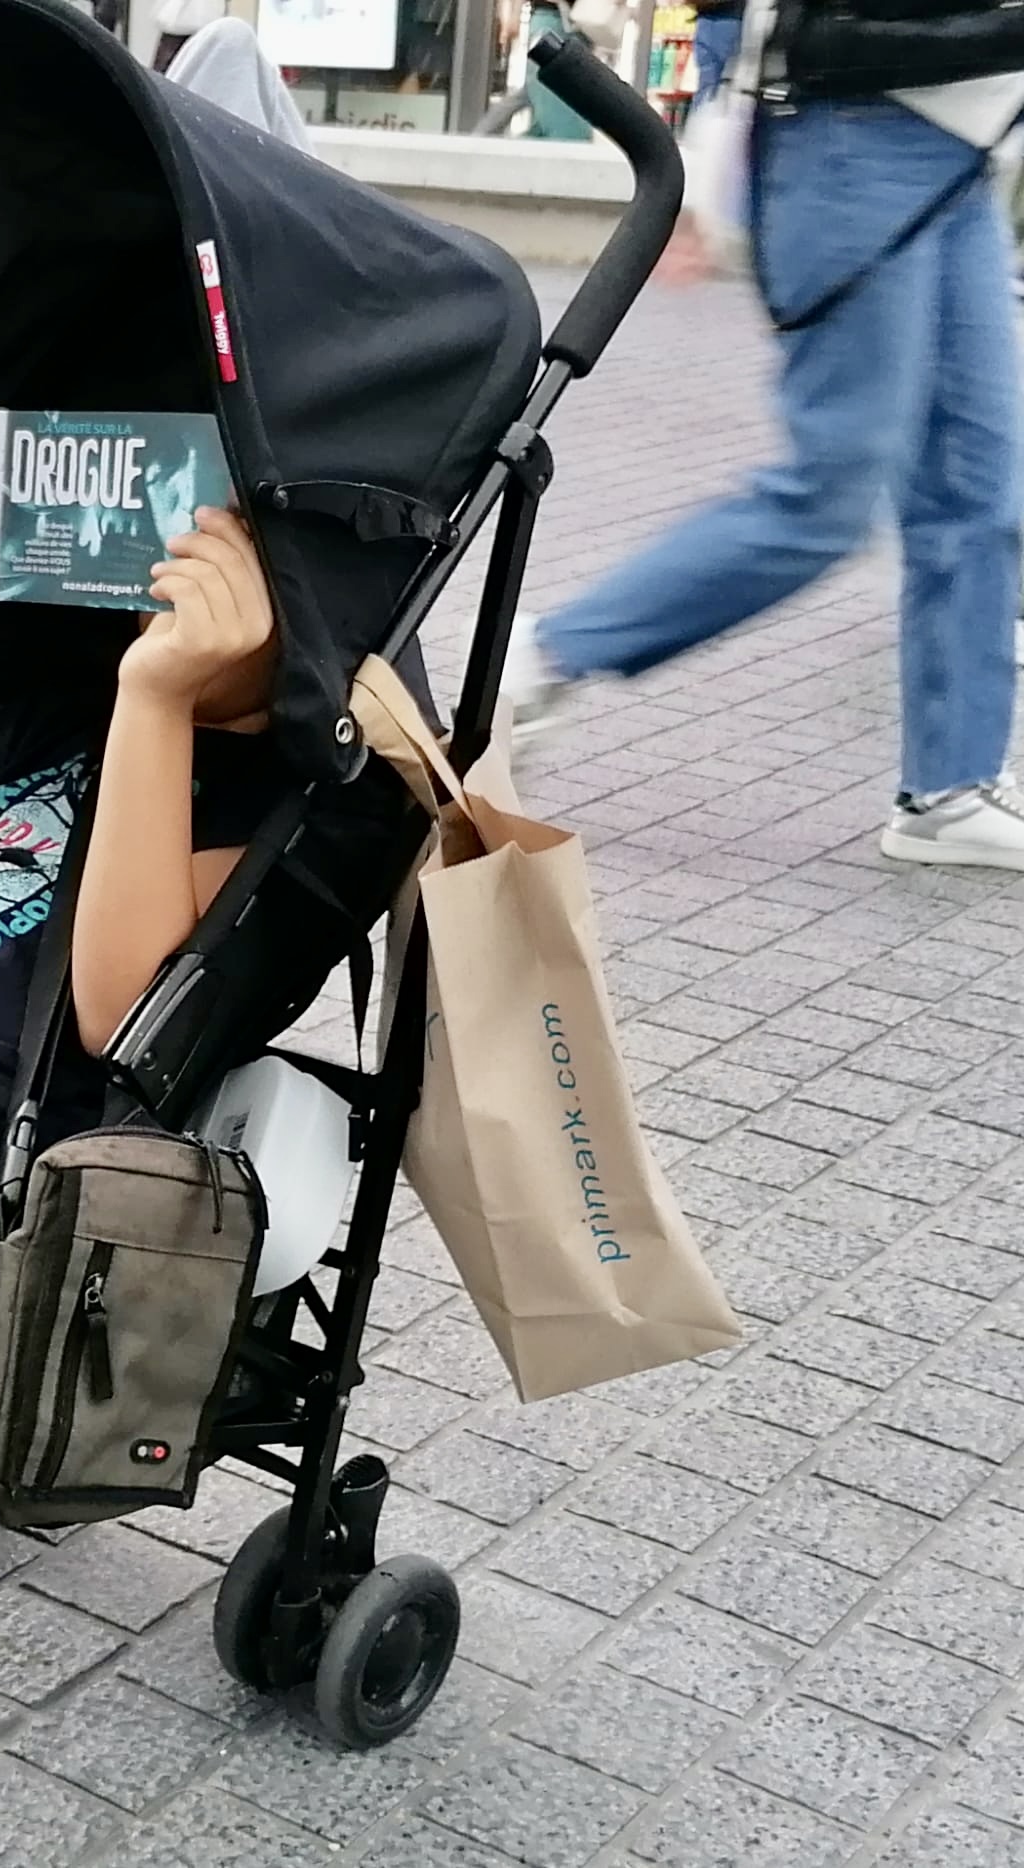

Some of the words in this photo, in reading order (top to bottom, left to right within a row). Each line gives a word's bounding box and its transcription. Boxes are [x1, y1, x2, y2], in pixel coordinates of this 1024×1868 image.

[37, 422, 52, 433] LA
[93, 423, 116, 434] SUR
[117, 423, 132, 434] LA
[10, 430, 147, 509] DROGUE
[61, 581, 144, 595] nonaladrogue.fr
[542, 1003, 631, 1264] primark.com
